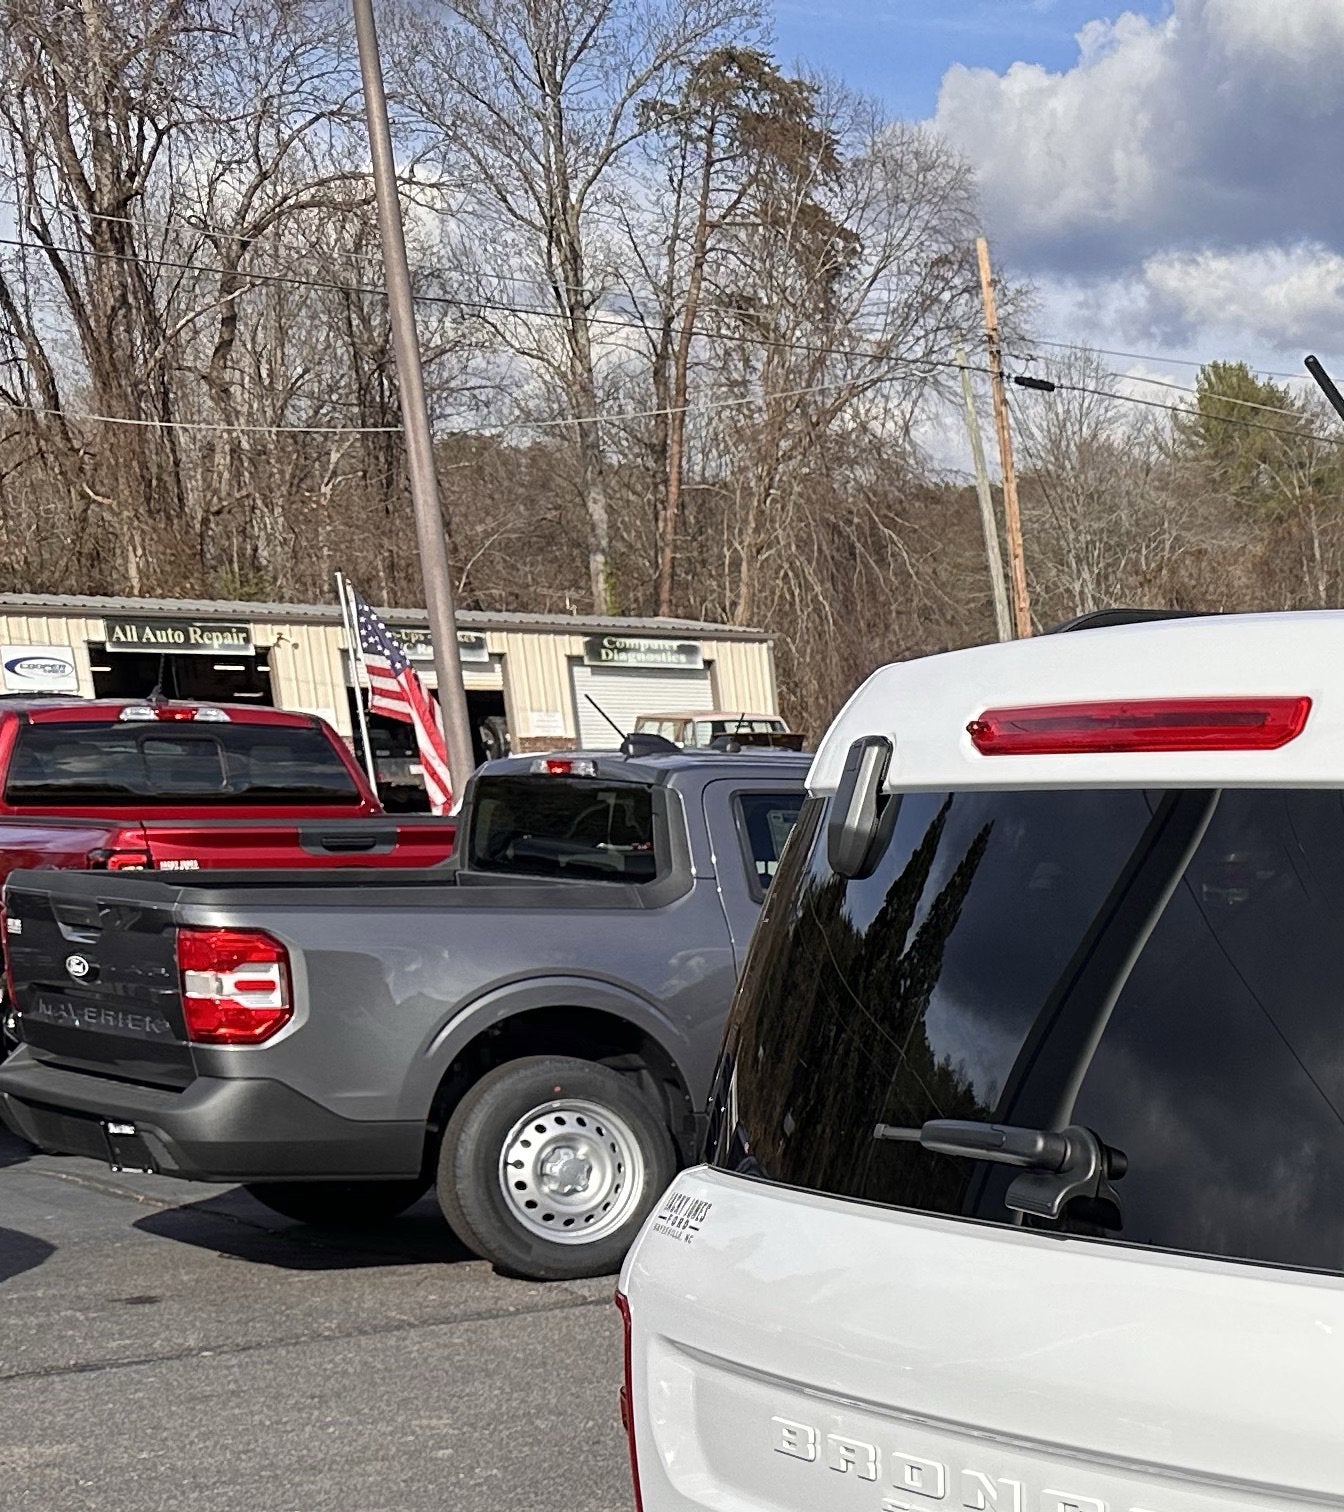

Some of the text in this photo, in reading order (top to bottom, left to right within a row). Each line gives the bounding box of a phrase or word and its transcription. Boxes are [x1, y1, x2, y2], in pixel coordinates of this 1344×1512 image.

[112, 625, 247, 648] All Auto Repair
[603, 636, 678, 651] Computer
[601, 648, 687, 663] Diagnostics
[666, 1213, 690, 1230] FORD
